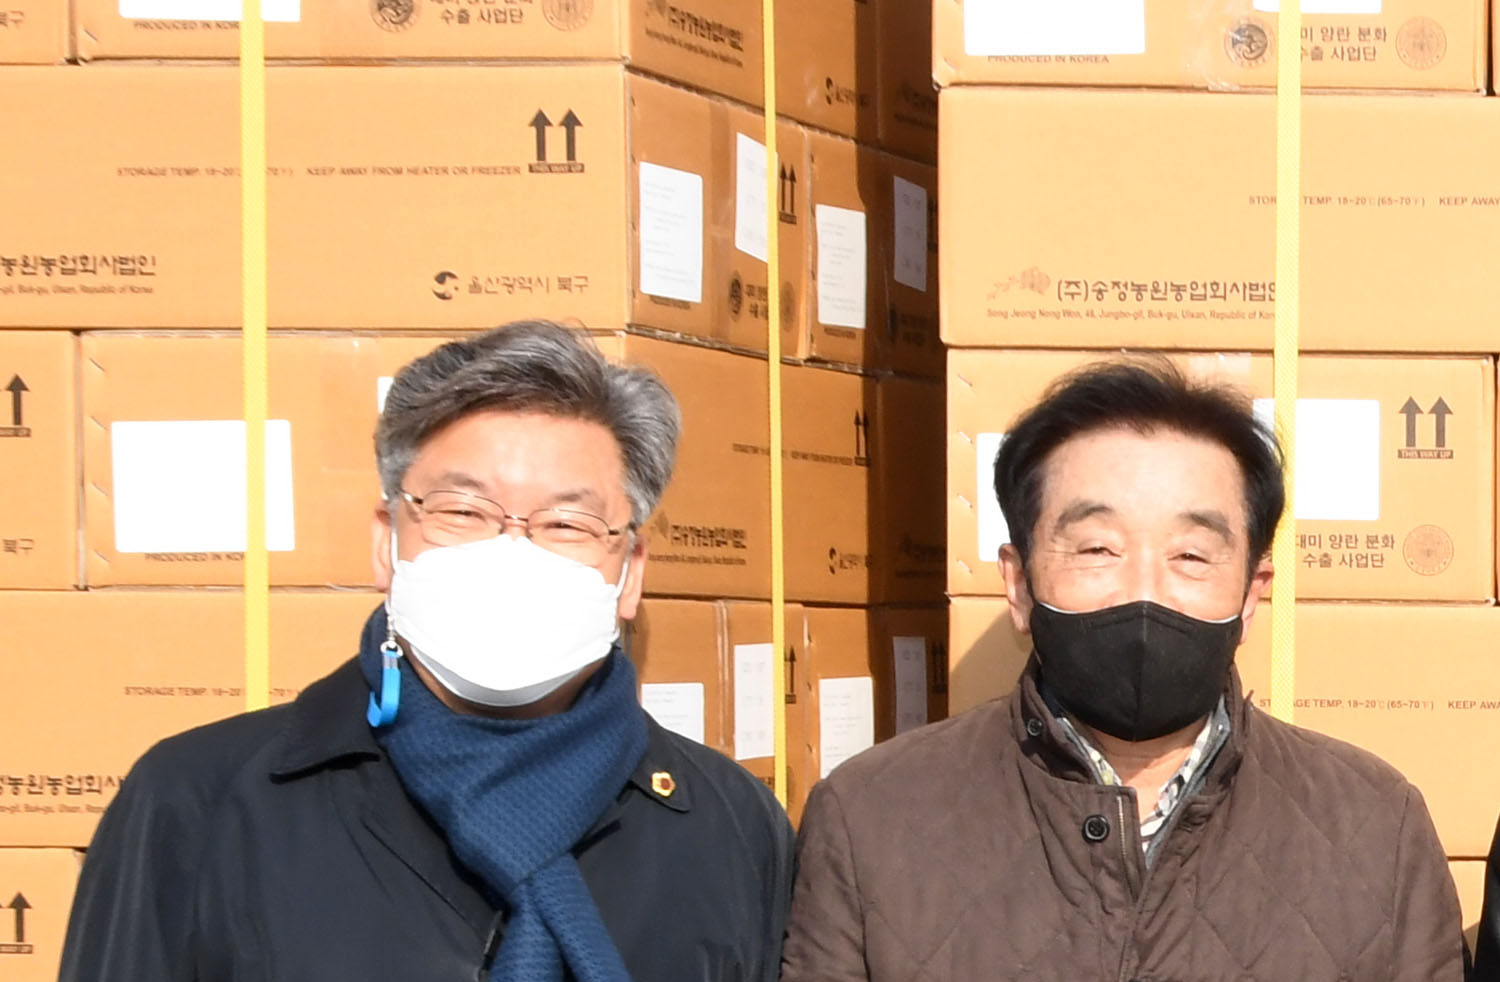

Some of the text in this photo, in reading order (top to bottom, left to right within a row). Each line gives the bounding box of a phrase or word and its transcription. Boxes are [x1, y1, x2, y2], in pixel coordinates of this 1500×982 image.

[215, 20, 240, 30] KOR
[1301, 26, 1313, 42] 미
[988, 55, 1109, 64] PRODUCED IN KOREA
[306, 166, 335, 176] KEEP
[340, 166, 368, 176] AWAY
[372, 166, 403, 176] FROM
[407, 166, 449, 176] HEATER
[452, 166, 469, 176] OR
[471, 166, 521, 176] FREEZER
[1439, 196, 1468, 206] KEEP
[1471, 196, 1500, 206] AWAY
[468, 276, 589, 294] 울산광역시 북구
[1329, 533, 1358, 549] 양란
[1365, 533, 1395, 549] 분화
[1303, 553, 1384, 568] 수출 사업단
[1448, 701, 1476, 711] KEEP
